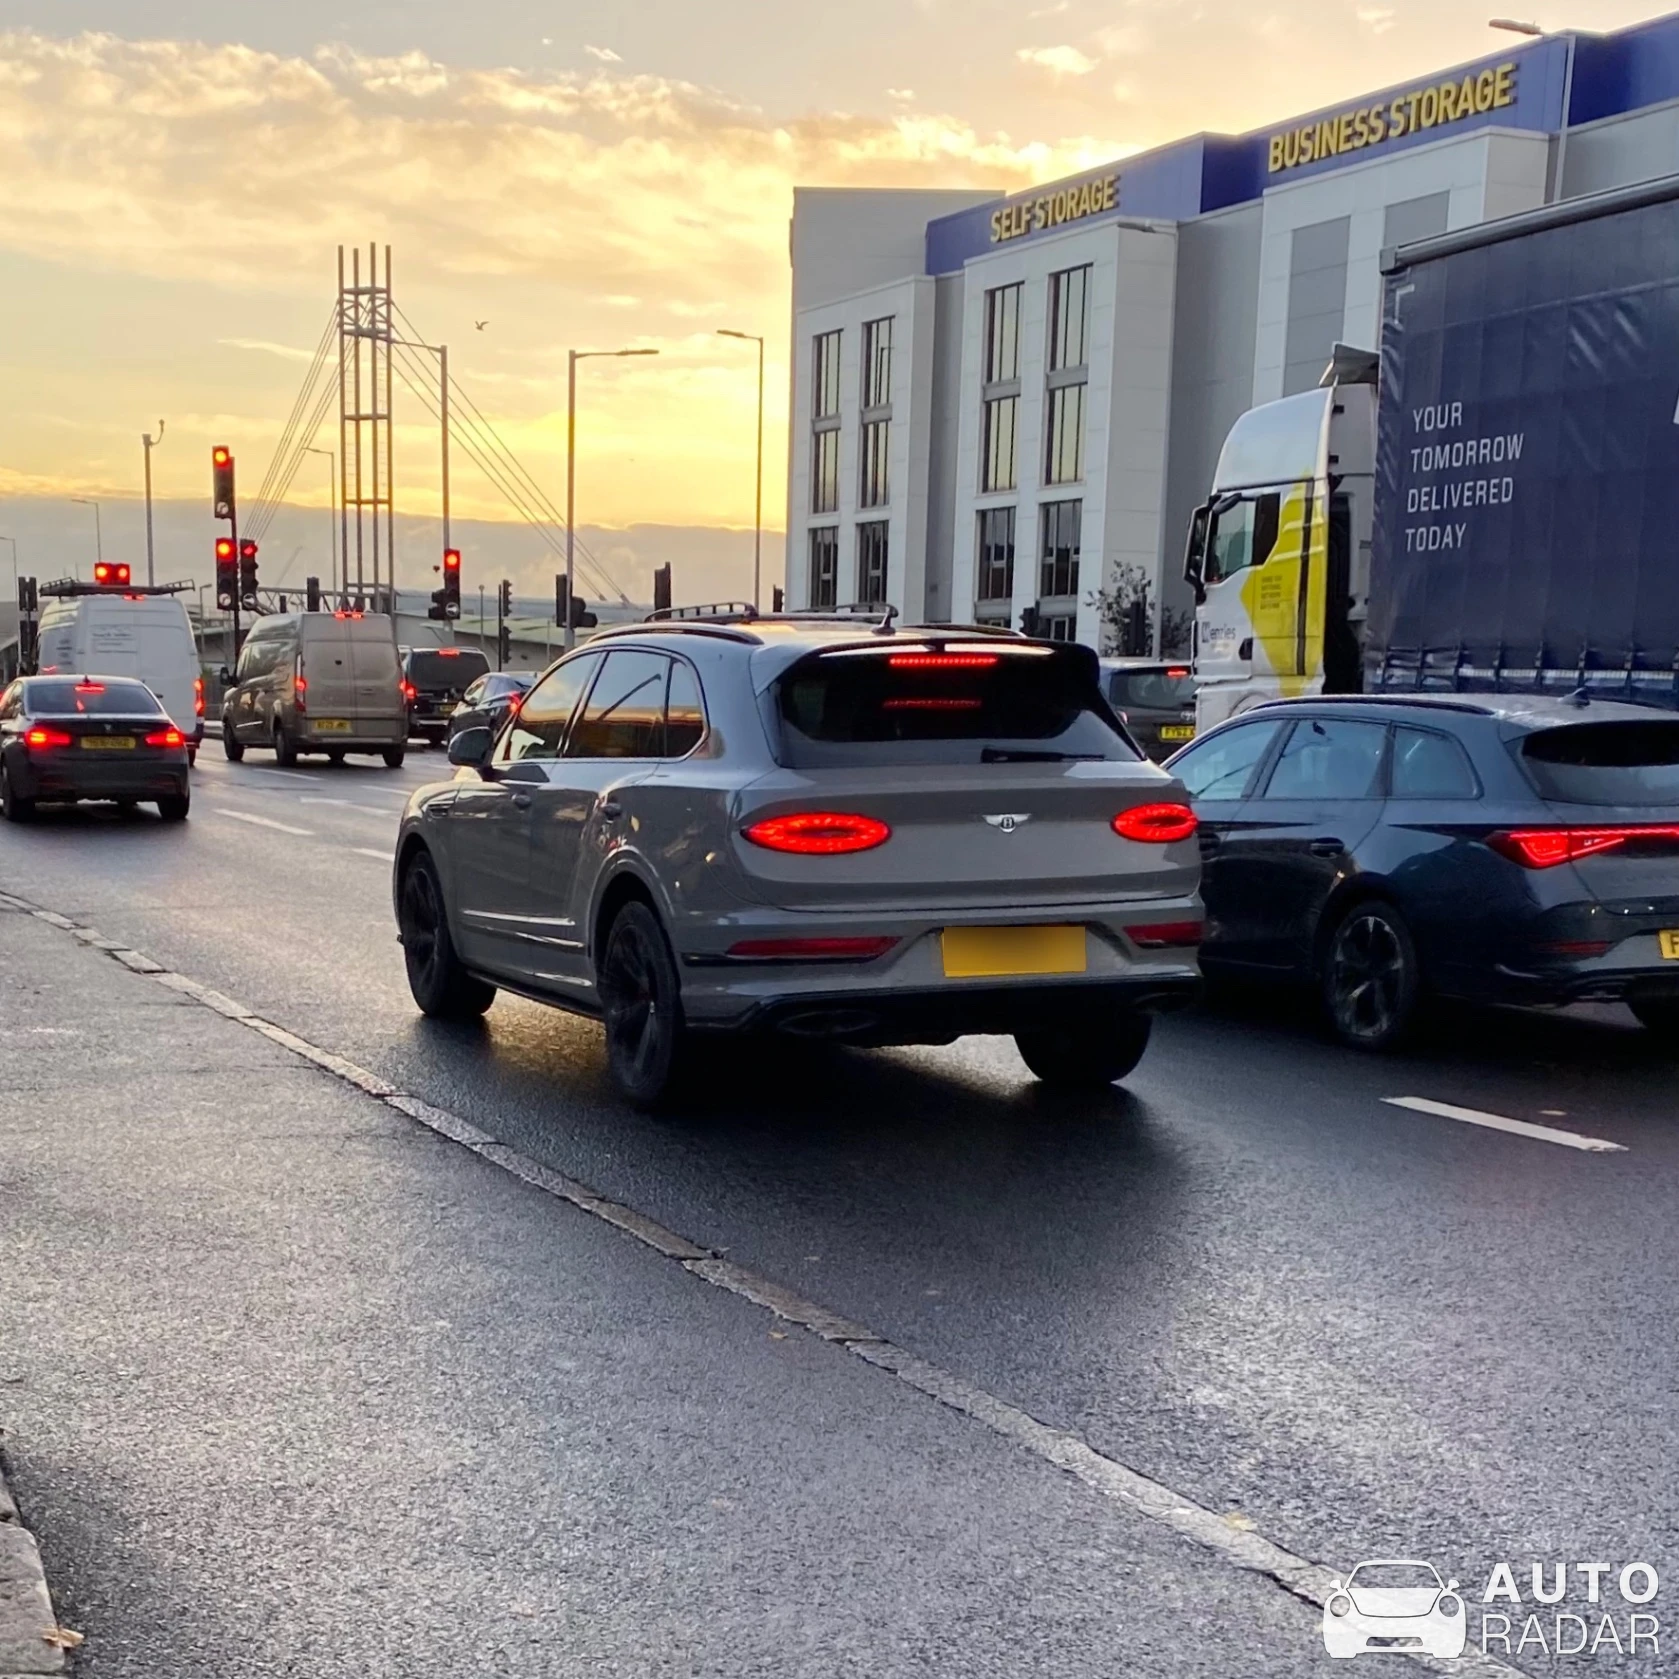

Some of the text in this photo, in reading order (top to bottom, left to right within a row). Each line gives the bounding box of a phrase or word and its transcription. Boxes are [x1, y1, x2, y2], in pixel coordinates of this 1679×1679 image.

[1268, 62, 1516, 172] BUSINESS STORAGE
[990, 174, 1119, 243] SELF STORAGE
[1413, 402, 1463, 433] YOUR
[1411, 433, 1524, 473] TOMORROW
[1407, 477, 1514, 513] DELIVERED
[1405, 523, 1467, 552] TODAY
